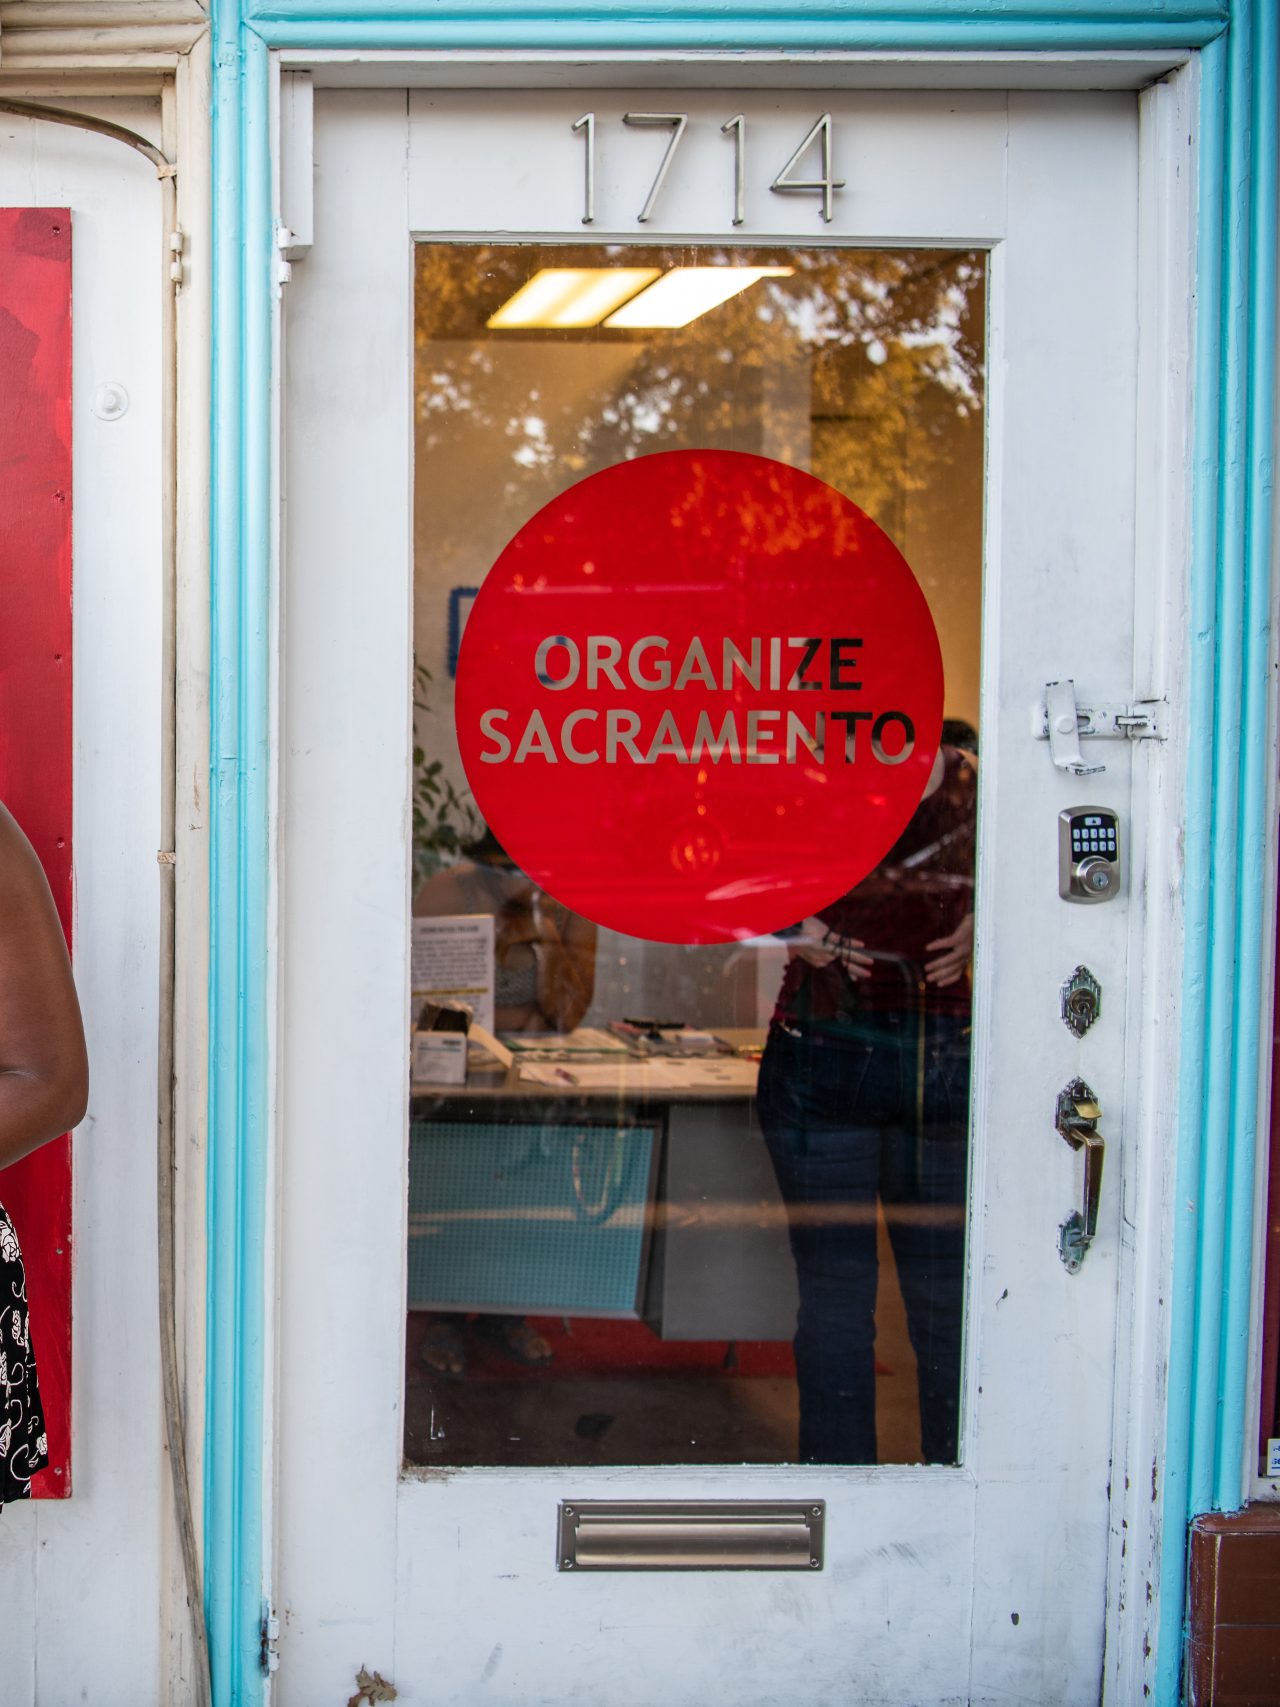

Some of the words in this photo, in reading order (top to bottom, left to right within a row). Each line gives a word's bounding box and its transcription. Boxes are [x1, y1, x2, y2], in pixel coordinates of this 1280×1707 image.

[571, 111, 847, 225] 1714
[533, 635, 864, 691] ORGANIZE
[478, 708, 916, 765] SACRAMENTO
